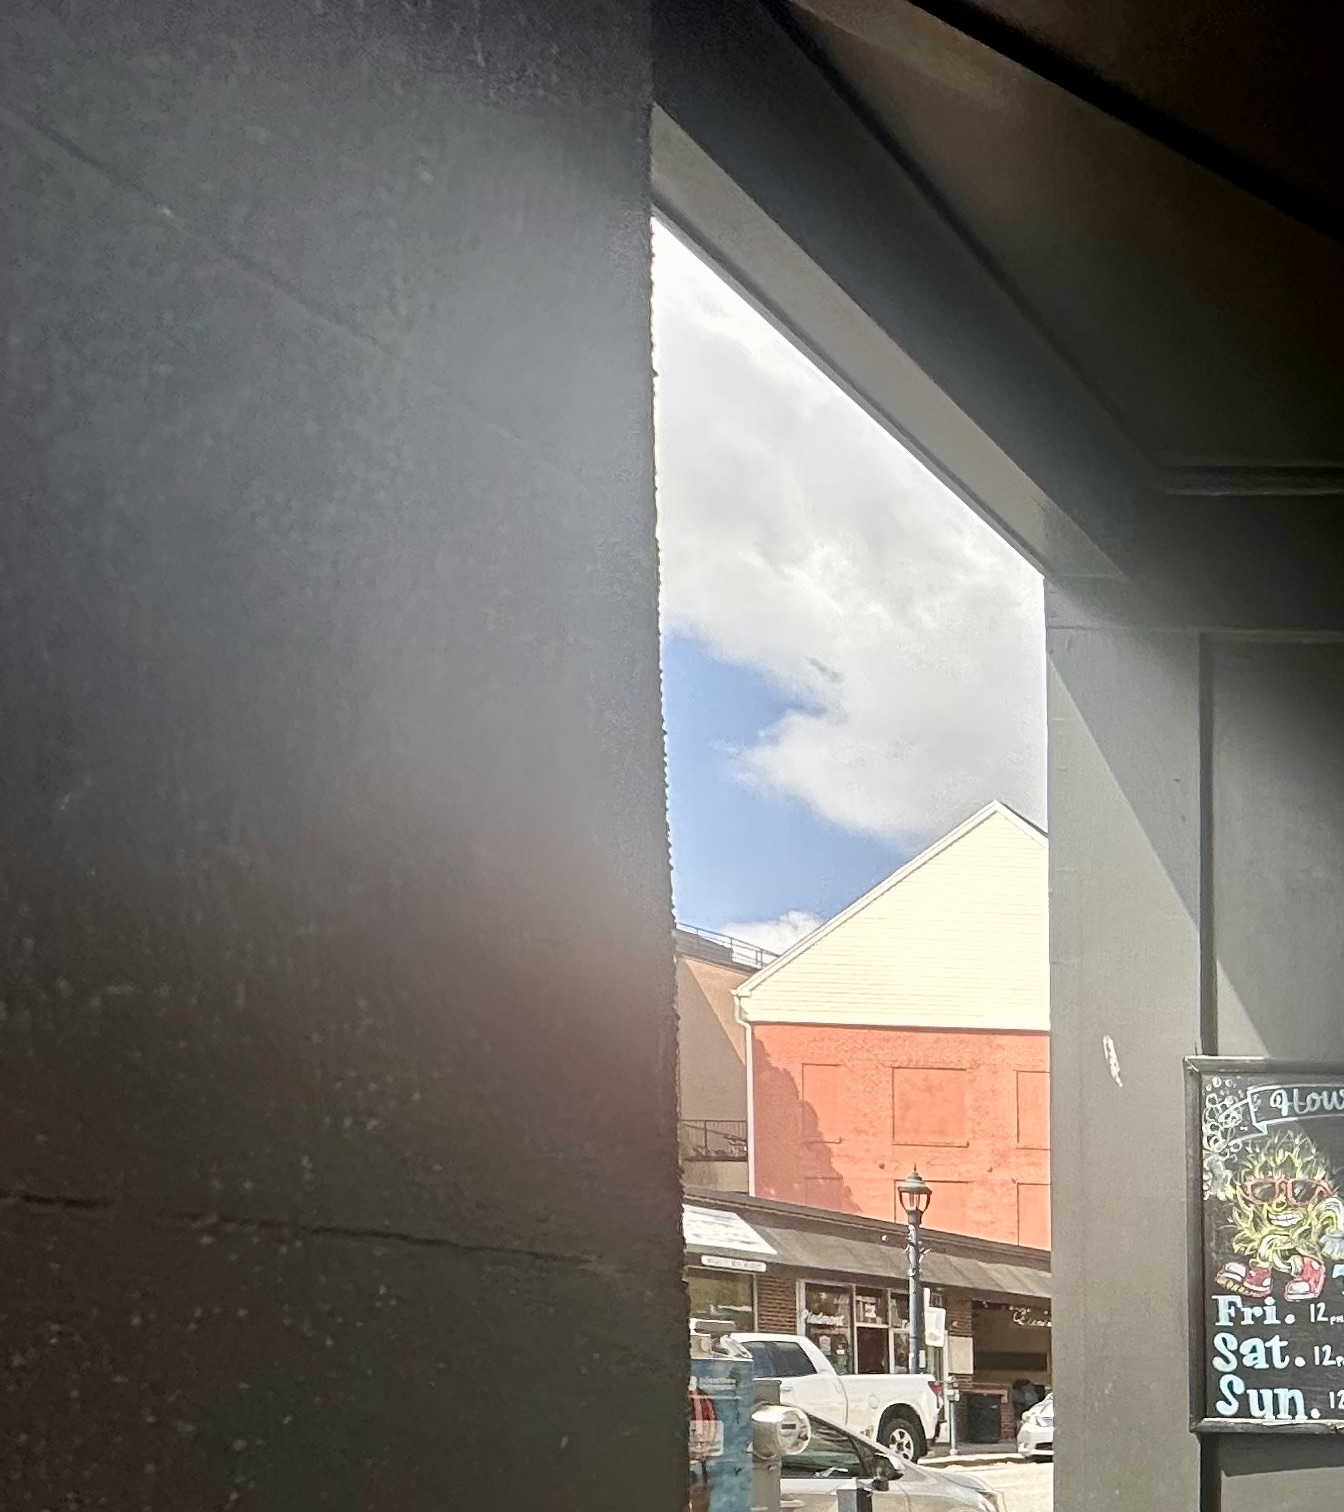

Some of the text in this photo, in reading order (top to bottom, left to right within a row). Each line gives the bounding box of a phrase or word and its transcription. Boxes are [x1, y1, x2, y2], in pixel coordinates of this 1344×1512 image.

[1212, 1295, 1296, 1327] Fri.
[1212, 1332, 1307, 1373] Sat.
[1215, 1373, 1321, 1420] Sun.
